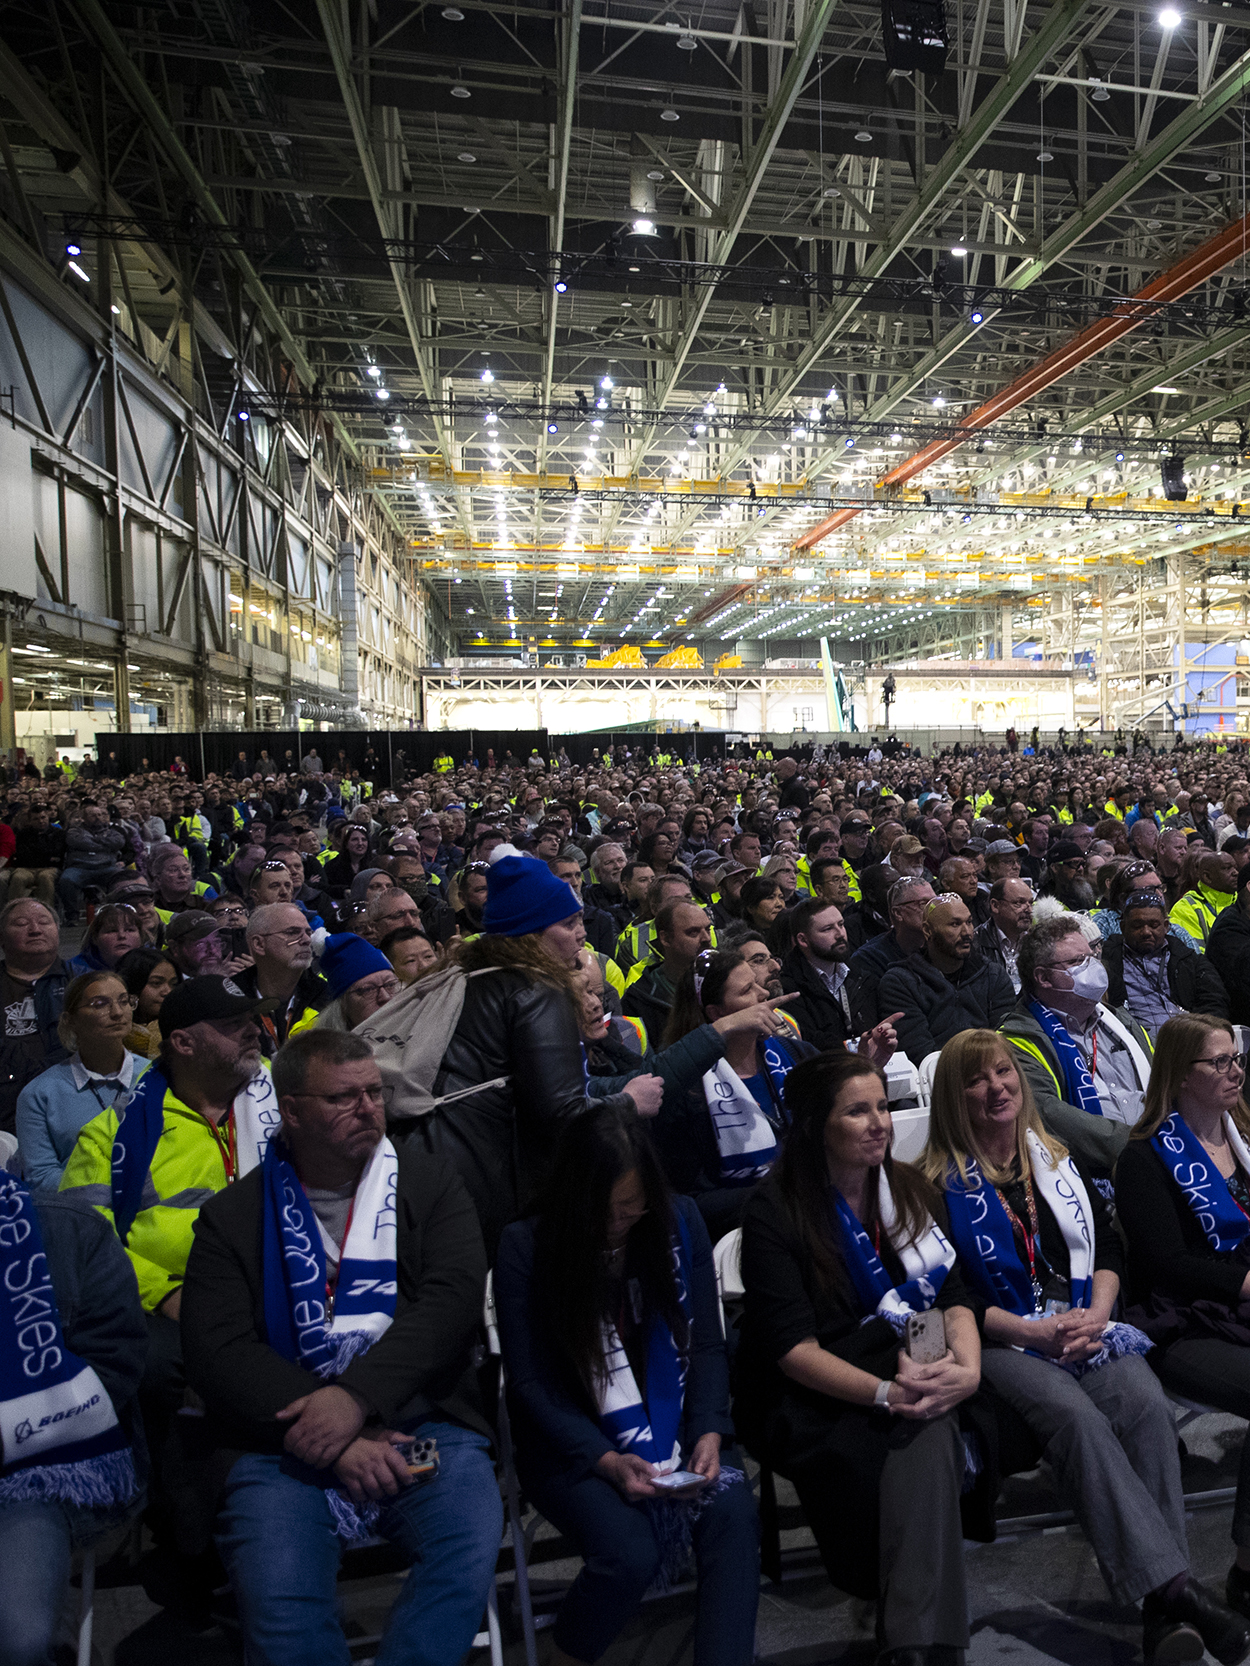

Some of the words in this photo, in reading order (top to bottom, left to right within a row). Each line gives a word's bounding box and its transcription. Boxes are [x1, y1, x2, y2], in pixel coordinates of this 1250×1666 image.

[711, 1081, 748, 1140] The
[346, 1279, 398, 1297] 74
[4, 1252, 63, 1378] Skies
[39, 1394, 101, 1427] BOEING
[616, 1425, 654, 1449] 74
